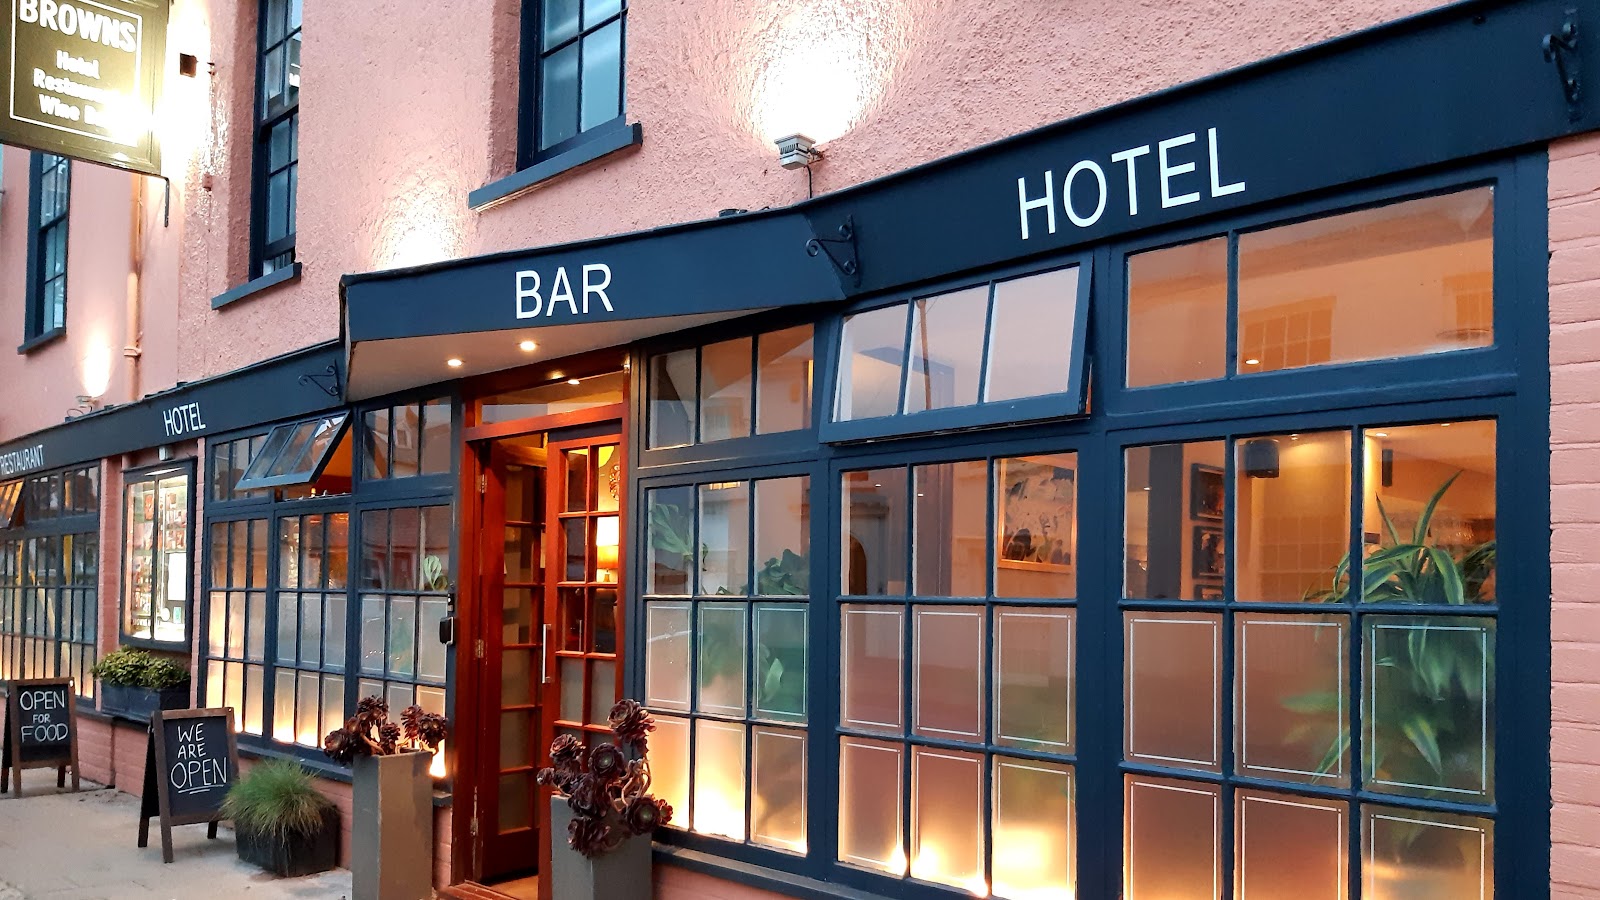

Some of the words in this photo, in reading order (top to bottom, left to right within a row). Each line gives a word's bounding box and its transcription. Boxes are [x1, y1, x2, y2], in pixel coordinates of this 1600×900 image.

[19, 0, 137, 52] BROWNS
[56, 50, 100, 79] Hotel
[39, 94, 80, 121] Wine
[1018, 127, 1246, 240] HOTEL
[515, 263, 614, 320] BAR
[163, 402, 206, 437] HOTEL
[0, 444, 44, 475] RESTAURANT
[20, 690, 65, 711] OPEN
[21, 723, 69, 743] FOOD
[33, 714, 51, 723] FOR
[177, 723, 205, 743] WE
[177, 743, 207, 759] ARE
[170, 757, 228, 789] OPEN
